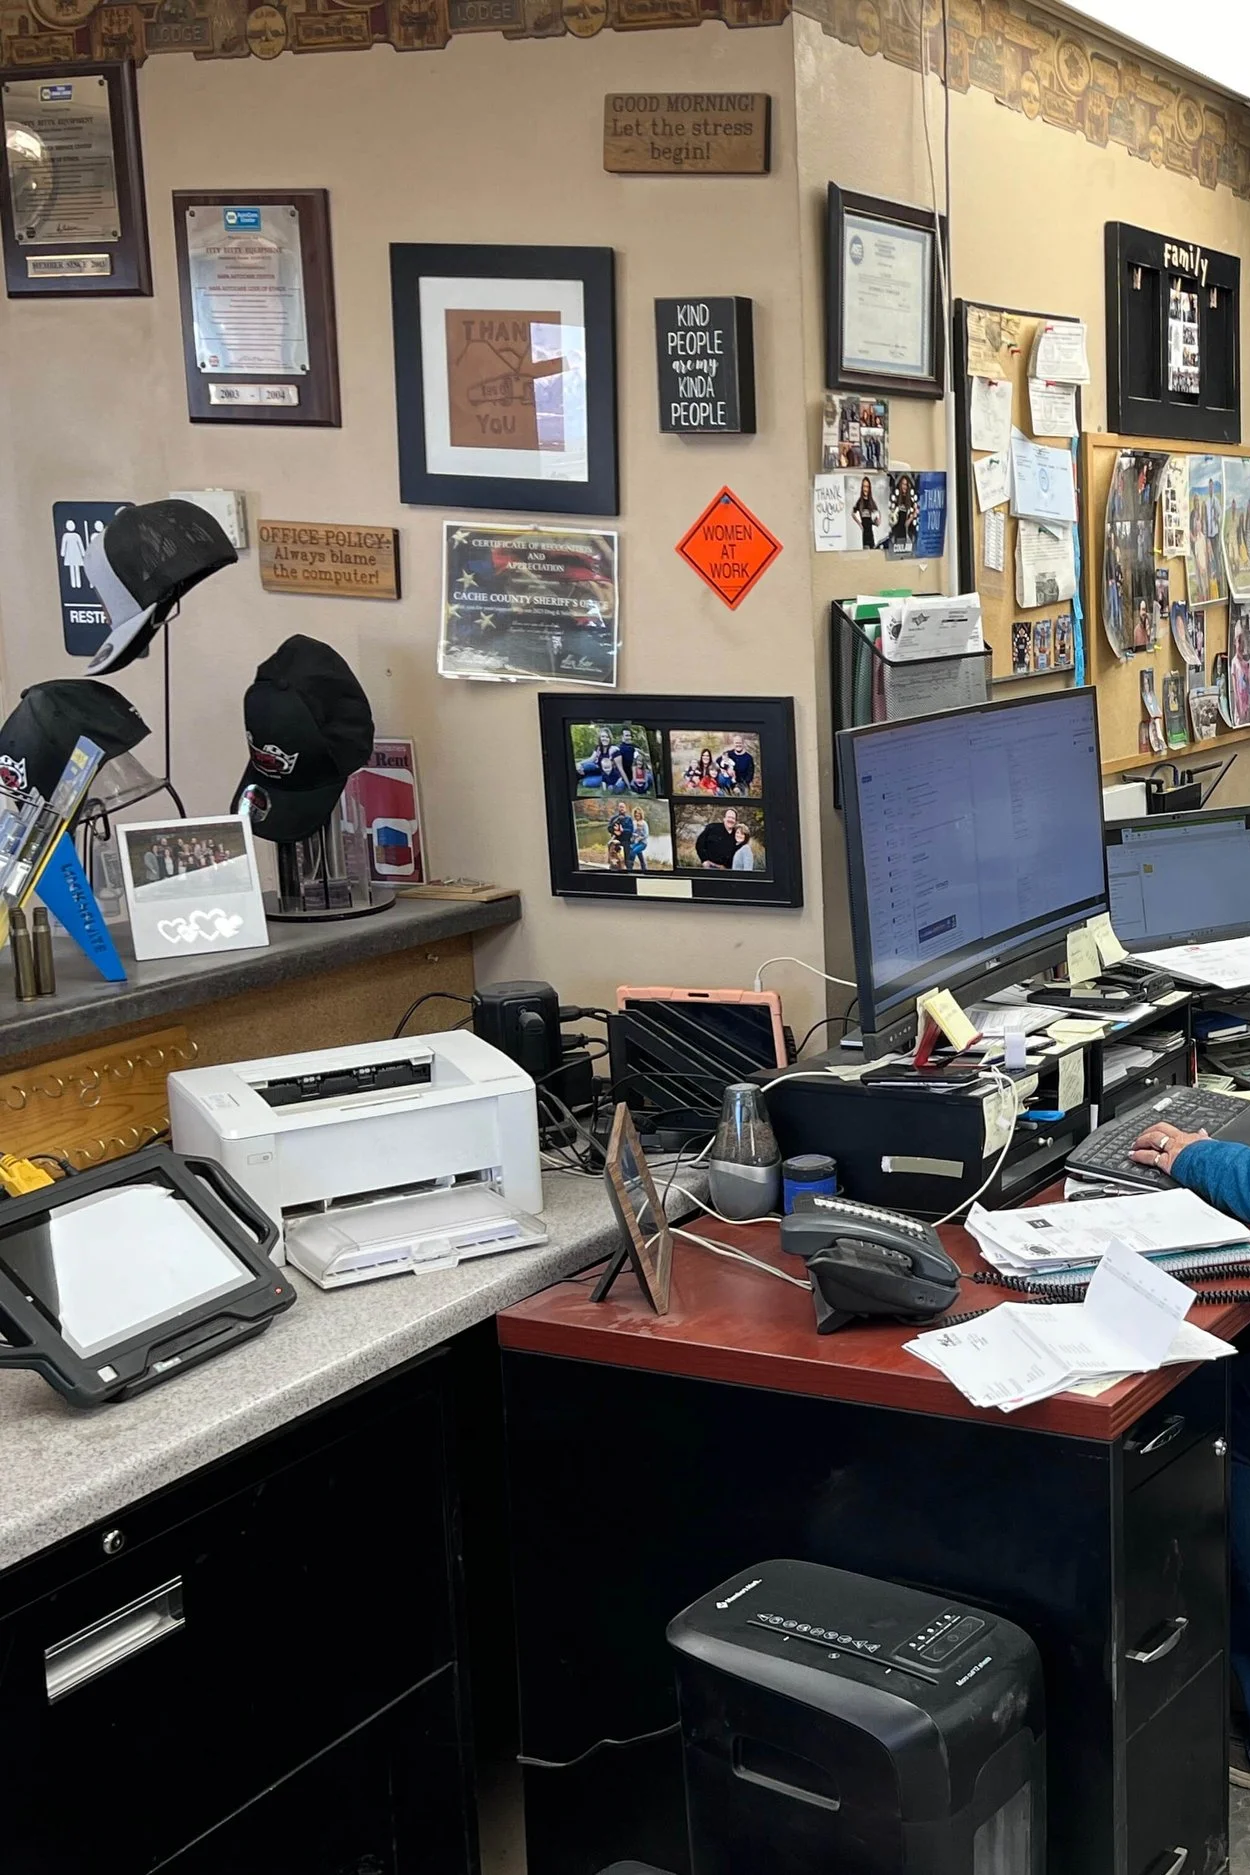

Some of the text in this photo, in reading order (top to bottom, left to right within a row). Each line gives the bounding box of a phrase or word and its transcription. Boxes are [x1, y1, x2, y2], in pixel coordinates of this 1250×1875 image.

[456, 4, 512, 21] LODGE
[152, 25, 202, 44] LODGE
[612, 95, 755, 113] GOOD MORNING!
[611, 118, 753, 137] Let the stress
[650, 142, 711, 164] begin!
[1164, 243, 1208, 287] Family
[677, 303, 710, 326] KIND
[667, 330, 724, 355] PEOPLE
[672, 358, 719, 378] are my
[220, 389, 239, 400] 2003
[266, 390, 285, 400] 2004
[678, 375, 715, 398] KINDA
[671, 401, 727, 426] PEOPLE
[927, 511, 941, 531] YOU
[260, 526, 319, 545] OFFICE
[702, 524, 753, 541] WOMEN
[472, 539, 593, 553] CERTIFICATE OF RECOGNITION
[720, 543, 737, 560] AT
[274, 546, 377, 566] Always blame
[527, 552, 546, 561] AND
[273, 563, 379, 586] the computer!
[506, 561, 565, 572] APPRECIATION
[709, 562, 750, 579] WORK
[453, 591, 488, 602] CACHE
[490, 593, 532, 604] COUNTY
[375, 752, 409, 768] Rent
